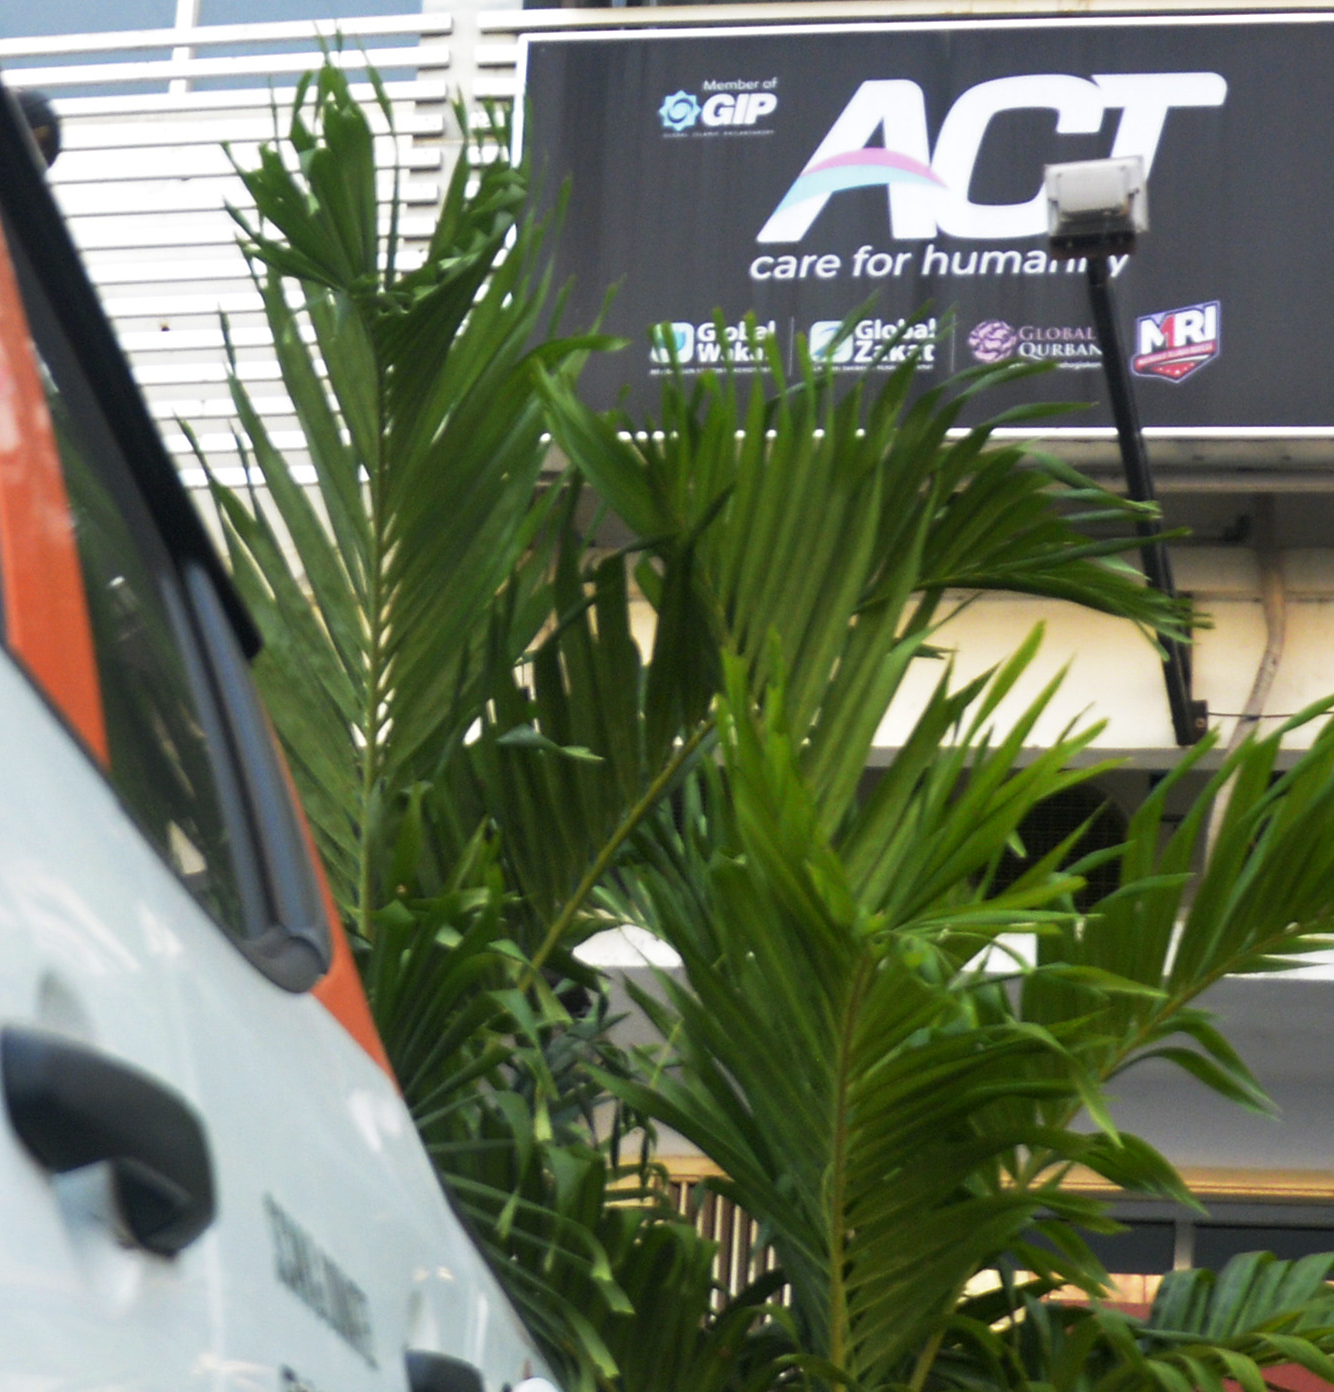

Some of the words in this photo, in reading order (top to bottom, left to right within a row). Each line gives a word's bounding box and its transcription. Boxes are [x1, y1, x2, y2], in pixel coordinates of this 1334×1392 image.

[703, 79, 759, 91] Member
[762, 77, 778, 89] of
[701, 92, 778, 127] GIP
[756, 72, 1228, 243] ACT
[749, 249, 842, 280] care
[852, 245, 913, 277] for
[921, 243, 1130, 279] humay
[697, 320, 776, 341] Goal
[1019, 325, 1097, 341] GLOBAL
[1019, 341, 1103, 360] QURBAN
